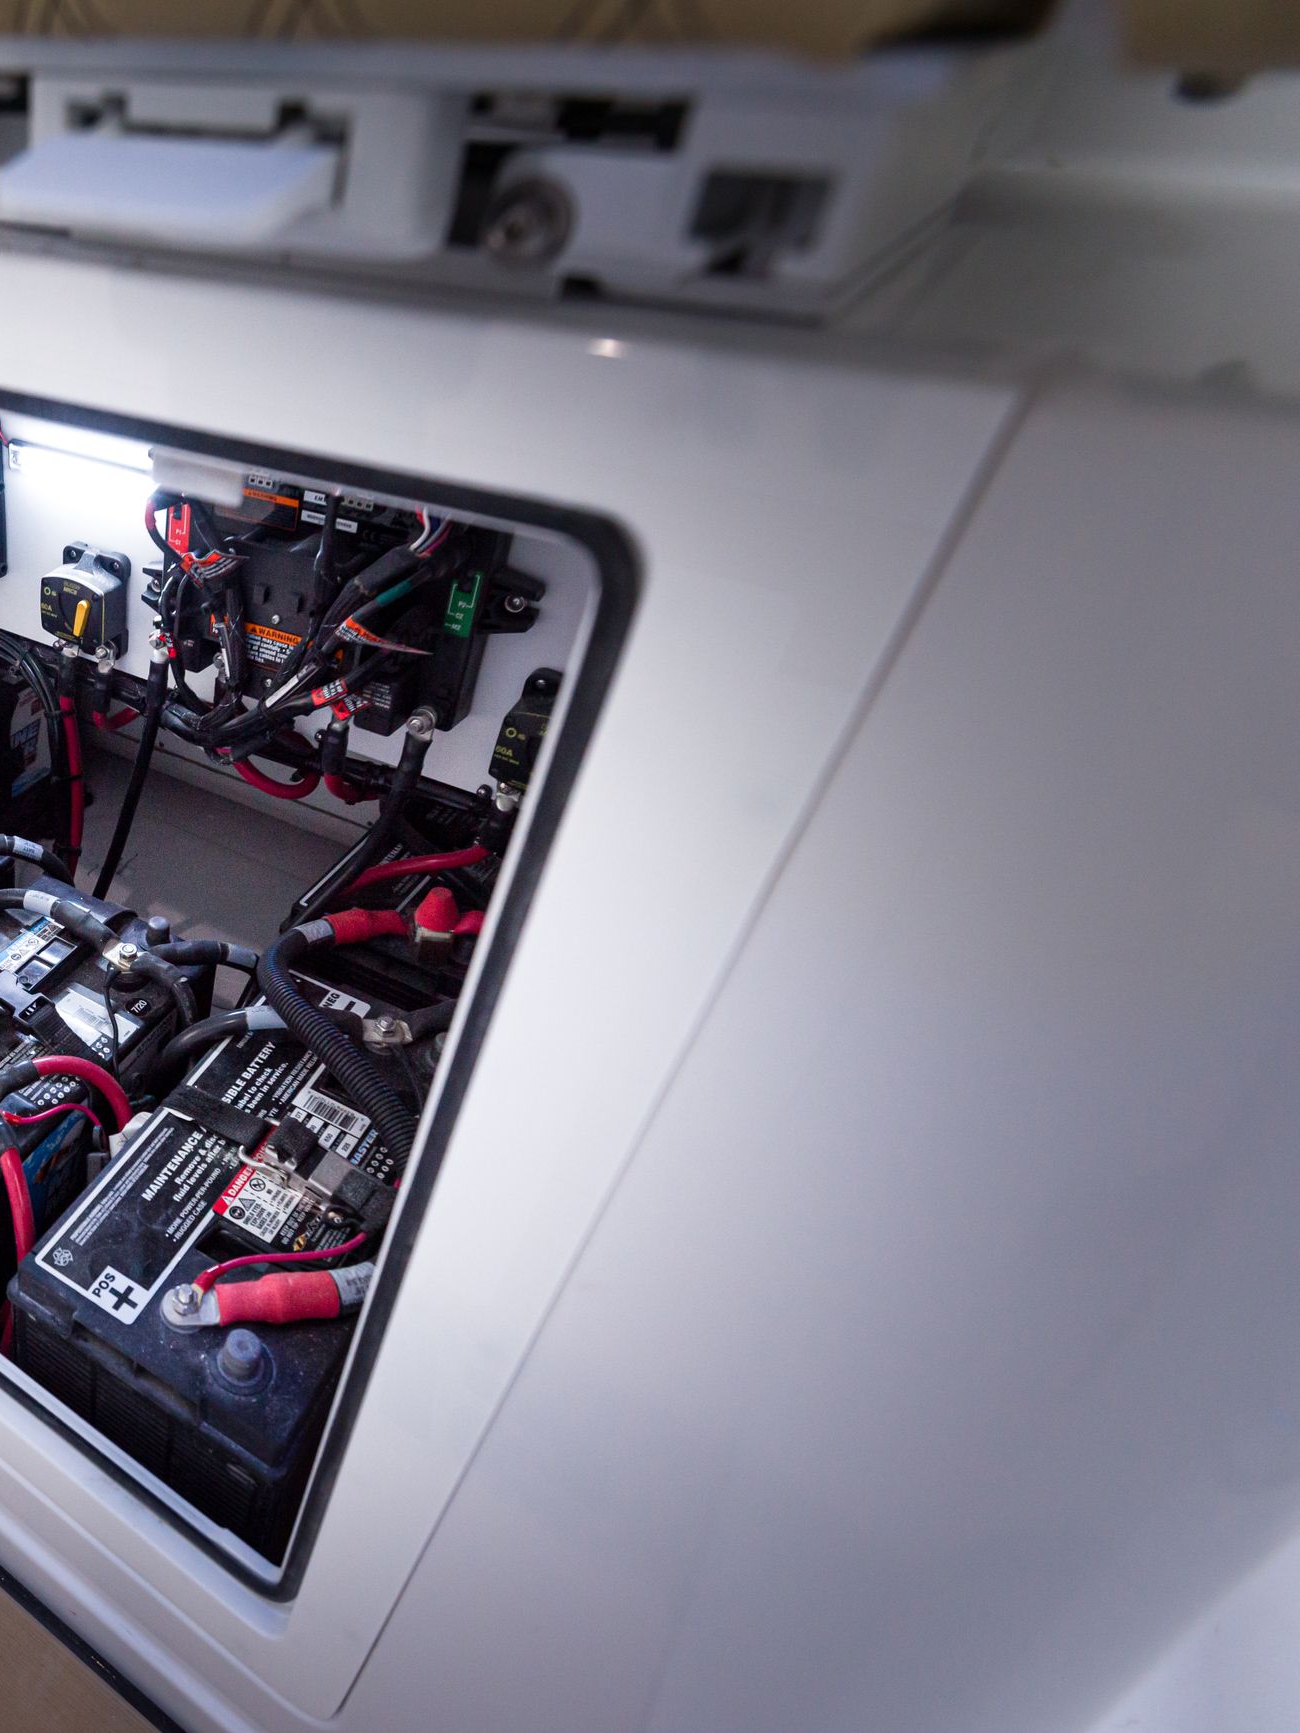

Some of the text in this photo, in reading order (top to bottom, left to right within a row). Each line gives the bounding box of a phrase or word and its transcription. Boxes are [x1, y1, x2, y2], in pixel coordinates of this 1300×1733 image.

[259, 627, 298, 643] WARNING
[495, 745, 512, 756] 60A
[130, 999, 147, 1013] 7/20
[140, 1129, 203, 1201] MAINTENANCE
[240, 1040, 277, 1081] BATTERY
[172, 1183, 191, 1202] fluid
[186, 1161, 208, 1185] levels
[203, 1143, 222, 1163] after
[246, 1089, 264, 1109] been
[265, 1059, 289, 1086] service.
[174, 1154, 201, 1185] Remove
[253, 1065, 273, 1087] check
[165, 1216, 183, 1234] MORE
[173, 1213, 196, 1239] RUGGED
[192, 1199, 207, 1216] CASE
[91, 1271, 116, 1298] POS
